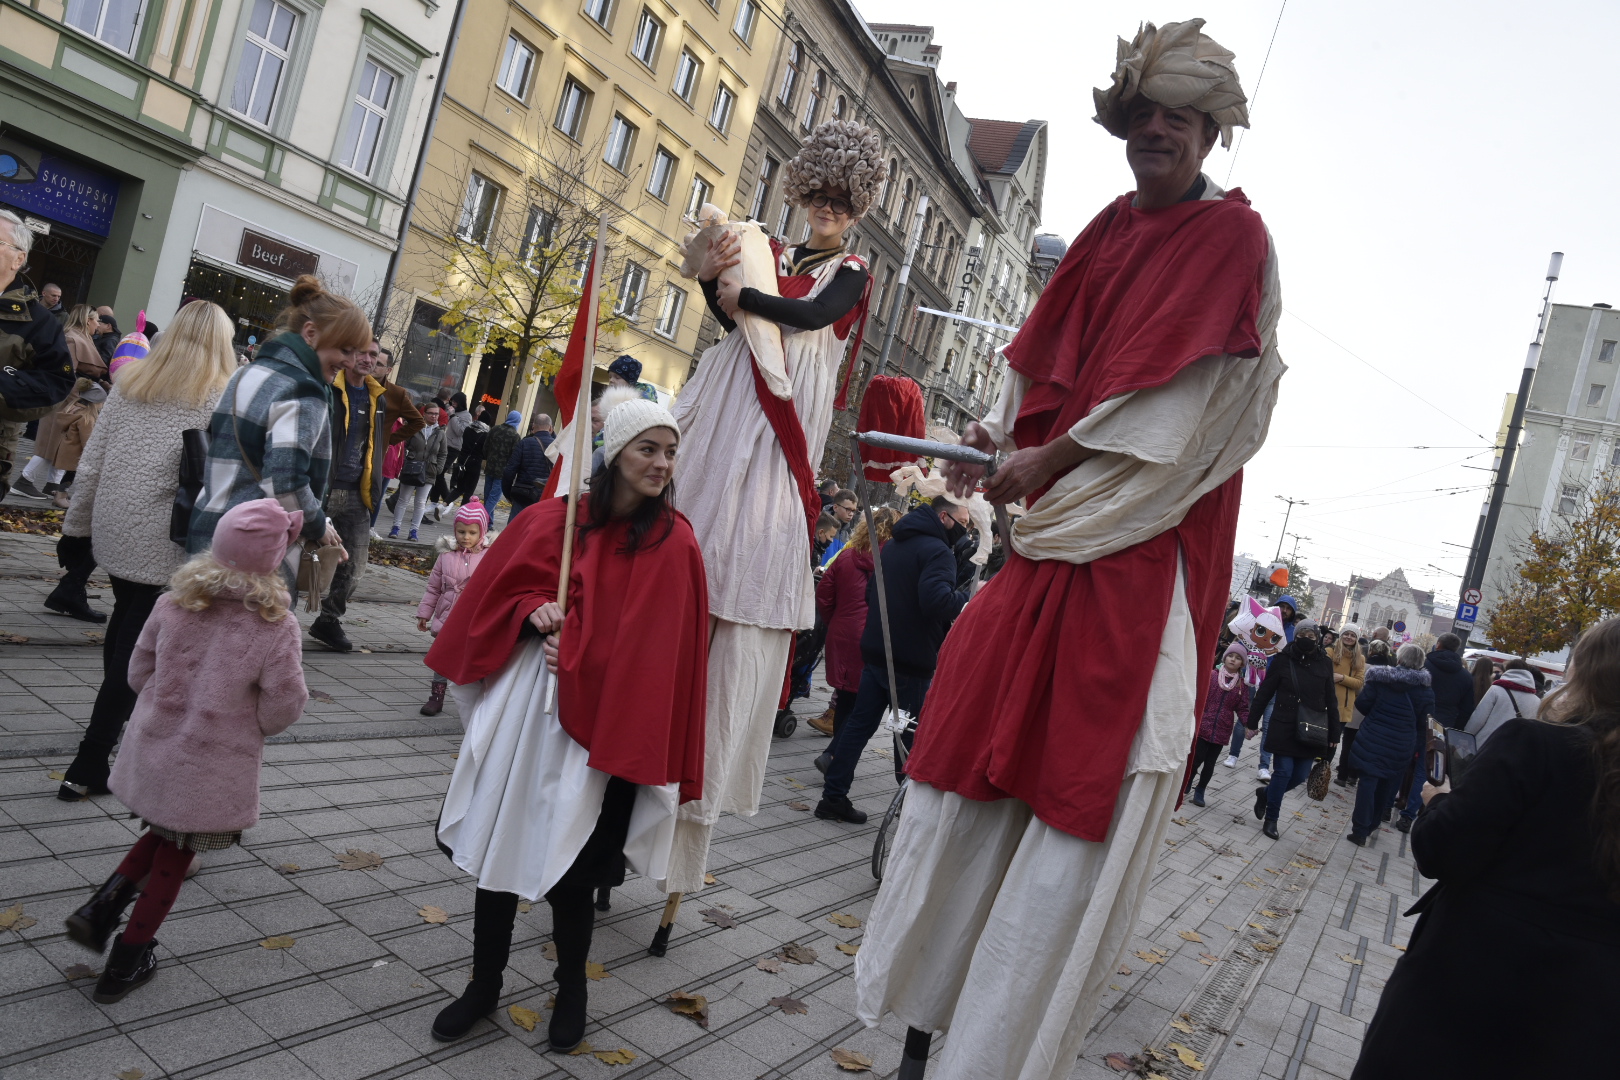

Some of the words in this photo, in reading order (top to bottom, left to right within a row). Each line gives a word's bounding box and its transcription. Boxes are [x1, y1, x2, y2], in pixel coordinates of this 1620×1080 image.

[42, 170, 113, 205] SKORUPSKI
[45, 187, 106, 213] optical
[953, 258, 976, 326] HOTEL
[1461, 605, 1474, 619] P
